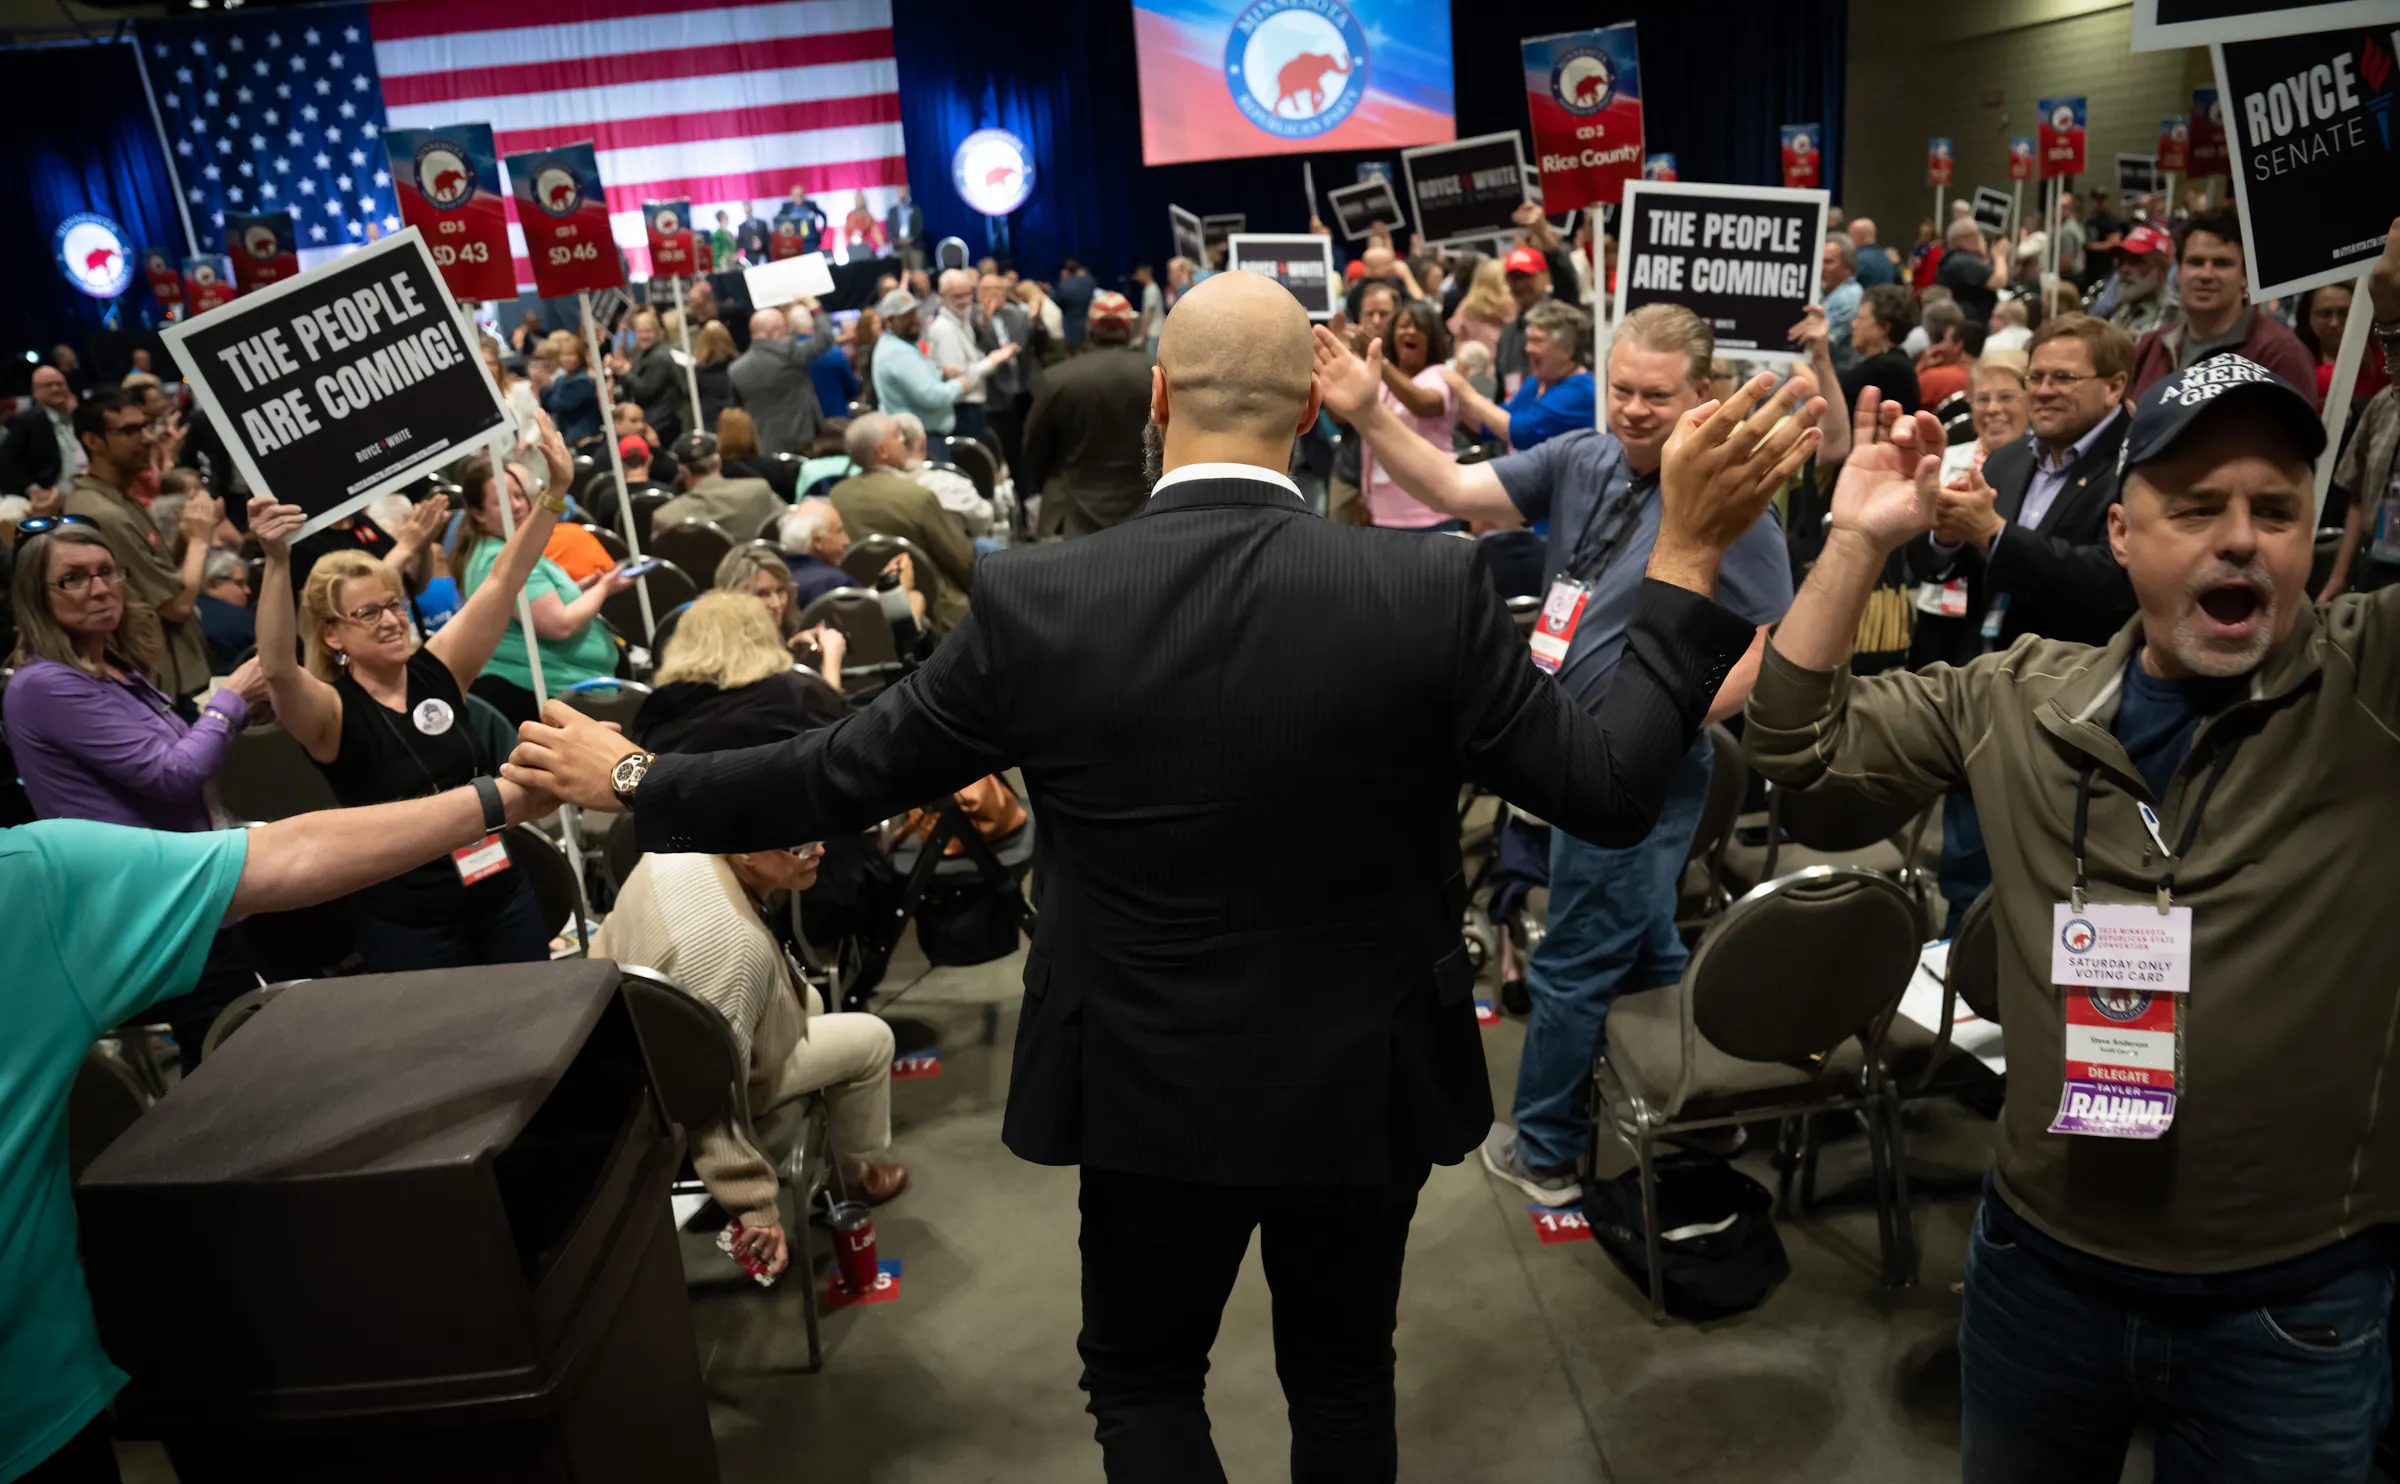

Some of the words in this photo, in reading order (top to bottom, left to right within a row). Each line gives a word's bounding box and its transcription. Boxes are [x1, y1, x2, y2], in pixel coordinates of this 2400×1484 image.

[2244, 52, 2360, 147] ROYCE
[1542, 154, 1579, 173] Rice
[1580, 143, 1641, 168] County
[2254, 116, 2366, 181] SENATE
[439, 221, 455, 234] CD
[457, 220, 466, 233] 5
[1648, 209, 1697, 247] THE
[1703, 213, 1802, 254] PEOPLE
[432, 245, 456, 266] SD
[459, 241, 489, 263] 43
[548, 247, 571, 265] SD
[573, 242, 598, 261] 46
[1632, 254, 1685, 291] ARE
[1691, 258, 1807, 299] COMING!
[217, 327, 299, 392] THE
[290, 271, 426, 362] PEOPLE
[241, 388, 322, 457] ARE
[315, 321, 465, 419] COMING!
[355, 442, 383, 463] ROYCE
[385, 428, 413, 448] WHITE
[2099, 935, 2147, 943] REPUBLICAN
[2120, 928, 2166, 936] MINNESOTA
[2098, 942, 2149, 950] CONVENTION
[2069, 957, 2133, 970] SATURDAY
[2138, 960, 2172, 971] ONLY
[2075, 969, 2123, 981] VOTING
[2128, 971, 2164, 982] CARD
[2088, 1066, 2149, 1084] DELEGATE
[2097, 1083, 2141, 1096] TAYLER
[2068, 1092, 2164, 1126] RAHM
